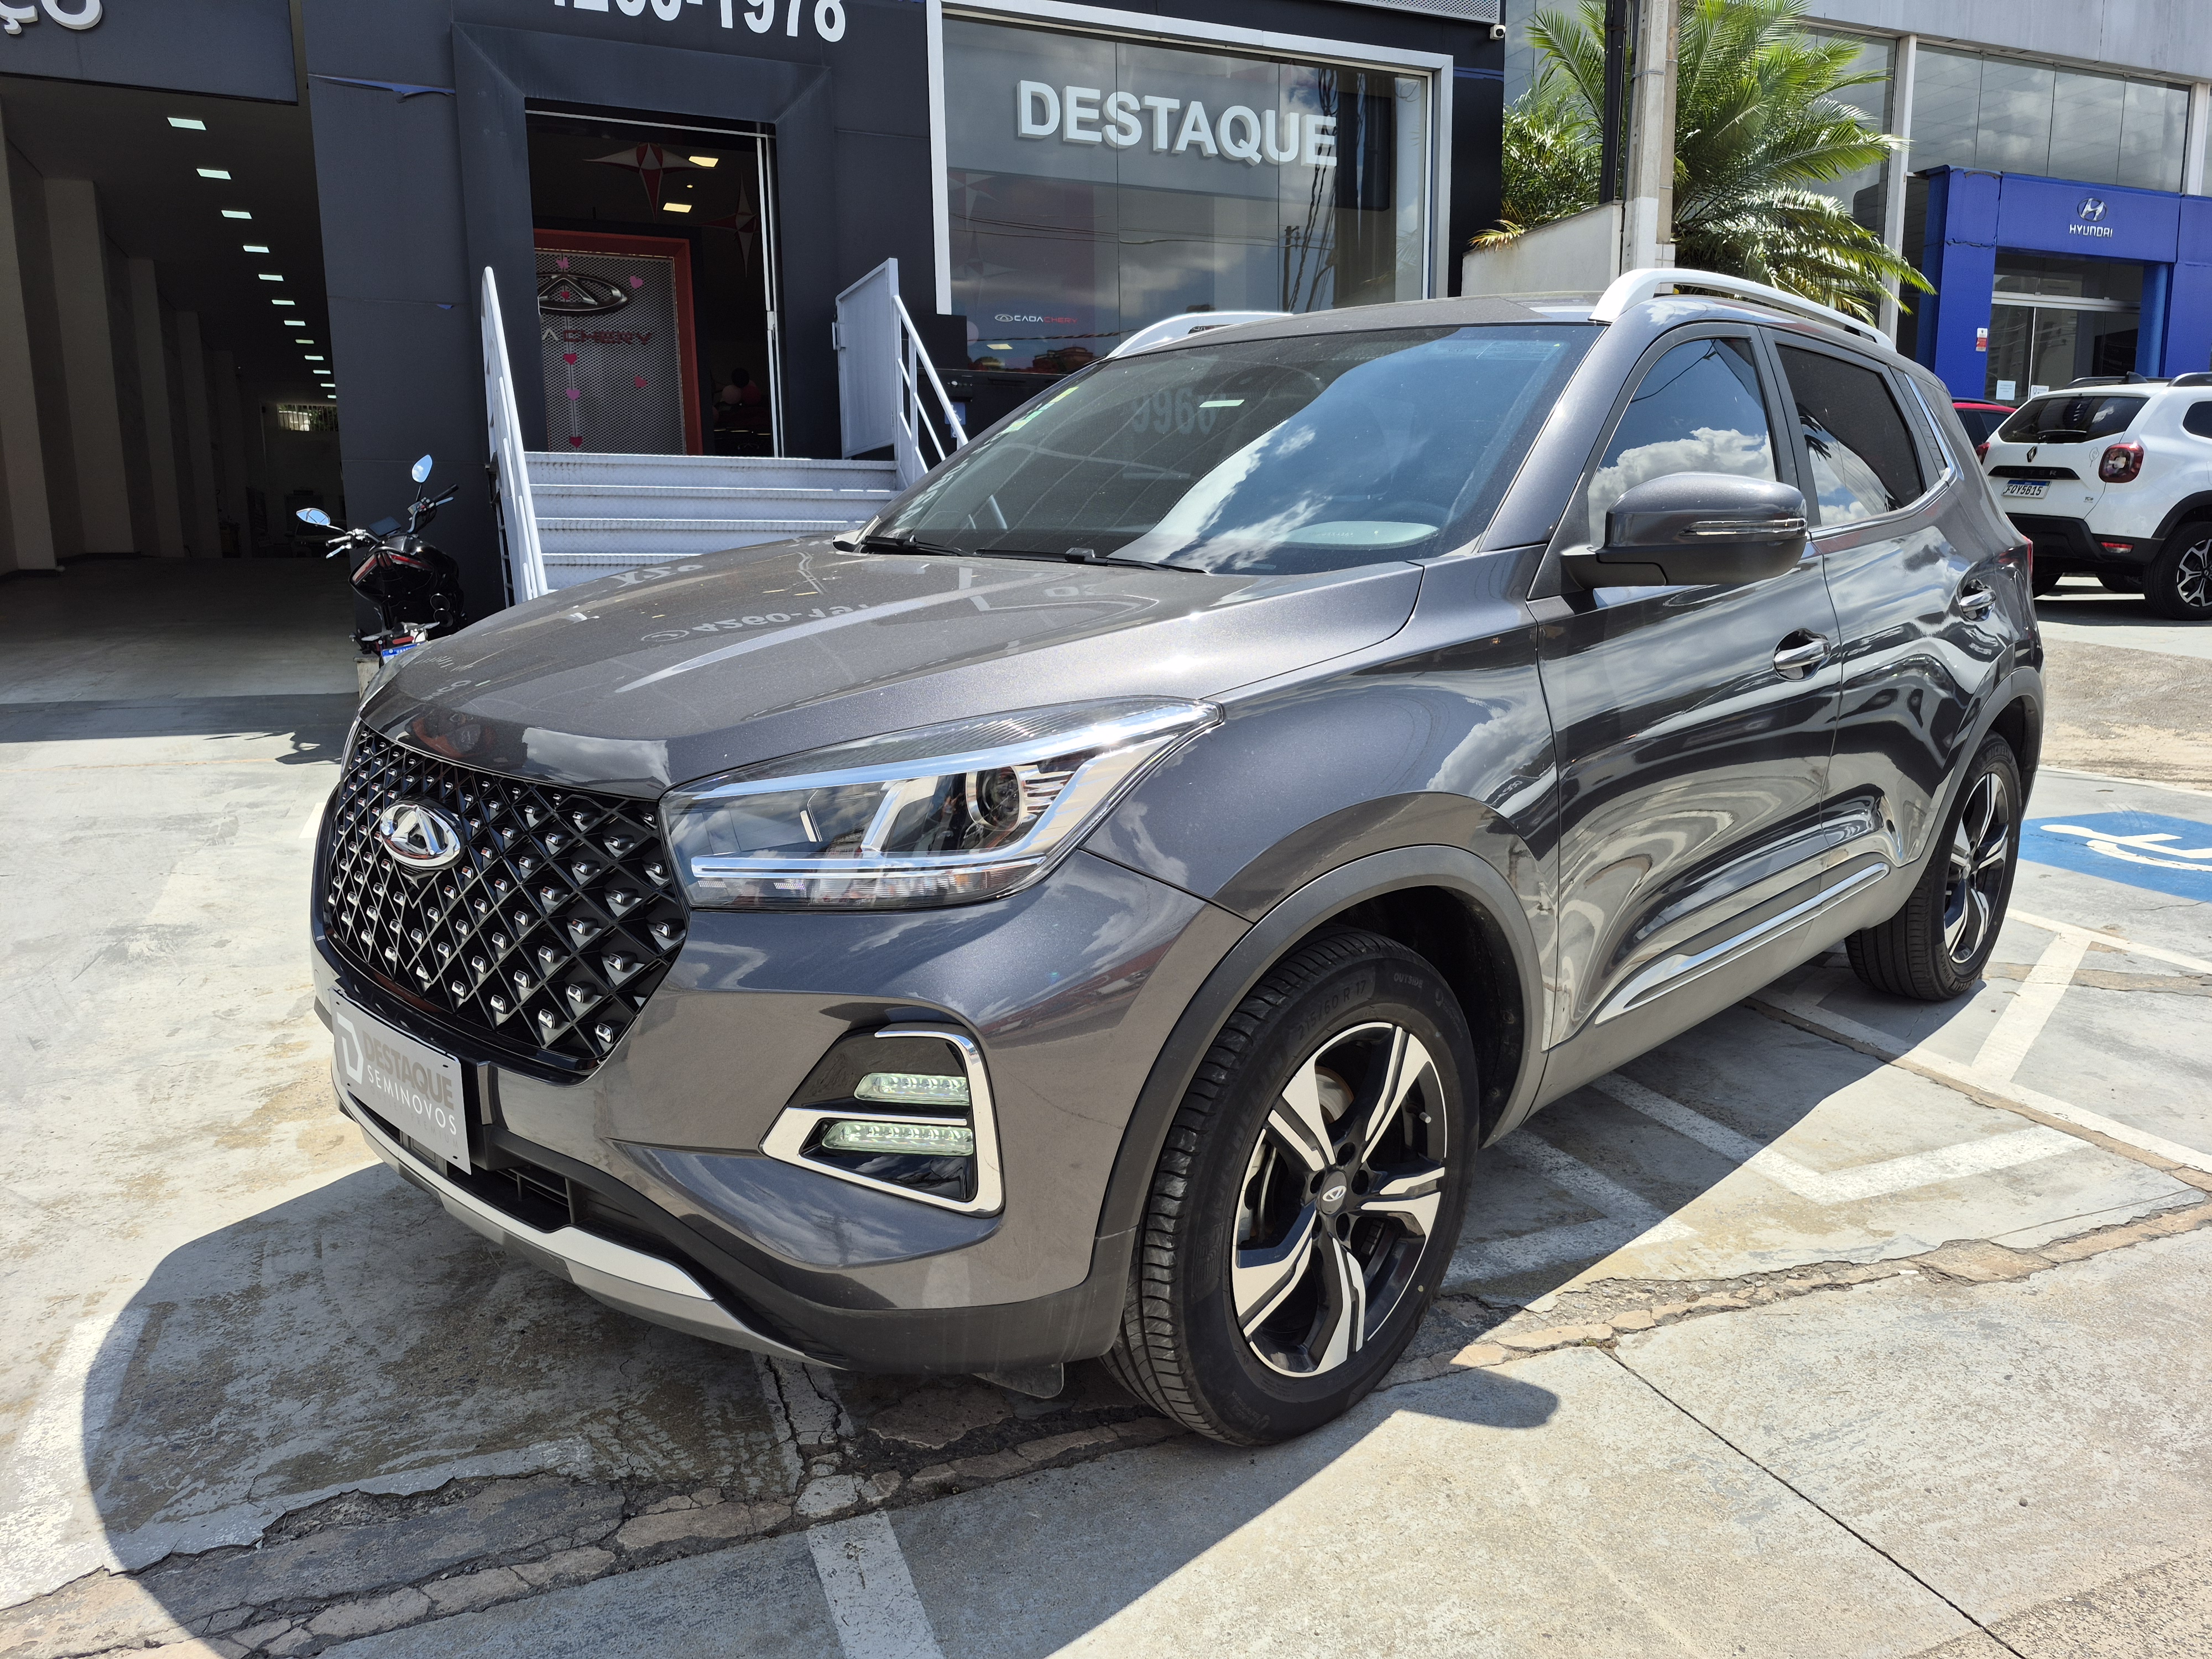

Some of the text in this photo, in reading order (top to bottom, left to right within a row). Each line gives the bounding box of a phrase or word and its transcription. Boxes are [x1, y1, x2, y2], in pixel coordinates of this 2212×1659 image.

[1016, 80, 1337, 167] DESTAQUE
[2069, 223, 2112, 238] HYUNDAI
[563, 329, 653, 346] CHERY
[1343, 987, 1351, 1003] R
[1355, 979, 1368, 994] 17
[1394, 972, 1423, 989] OUTSIDE
[362, 1029, 455, 1110] DESTAQUE
[367, 1064, 457, 1135] SEMINOVOS
[410, 1112, 459, 1150] PREMIUM
